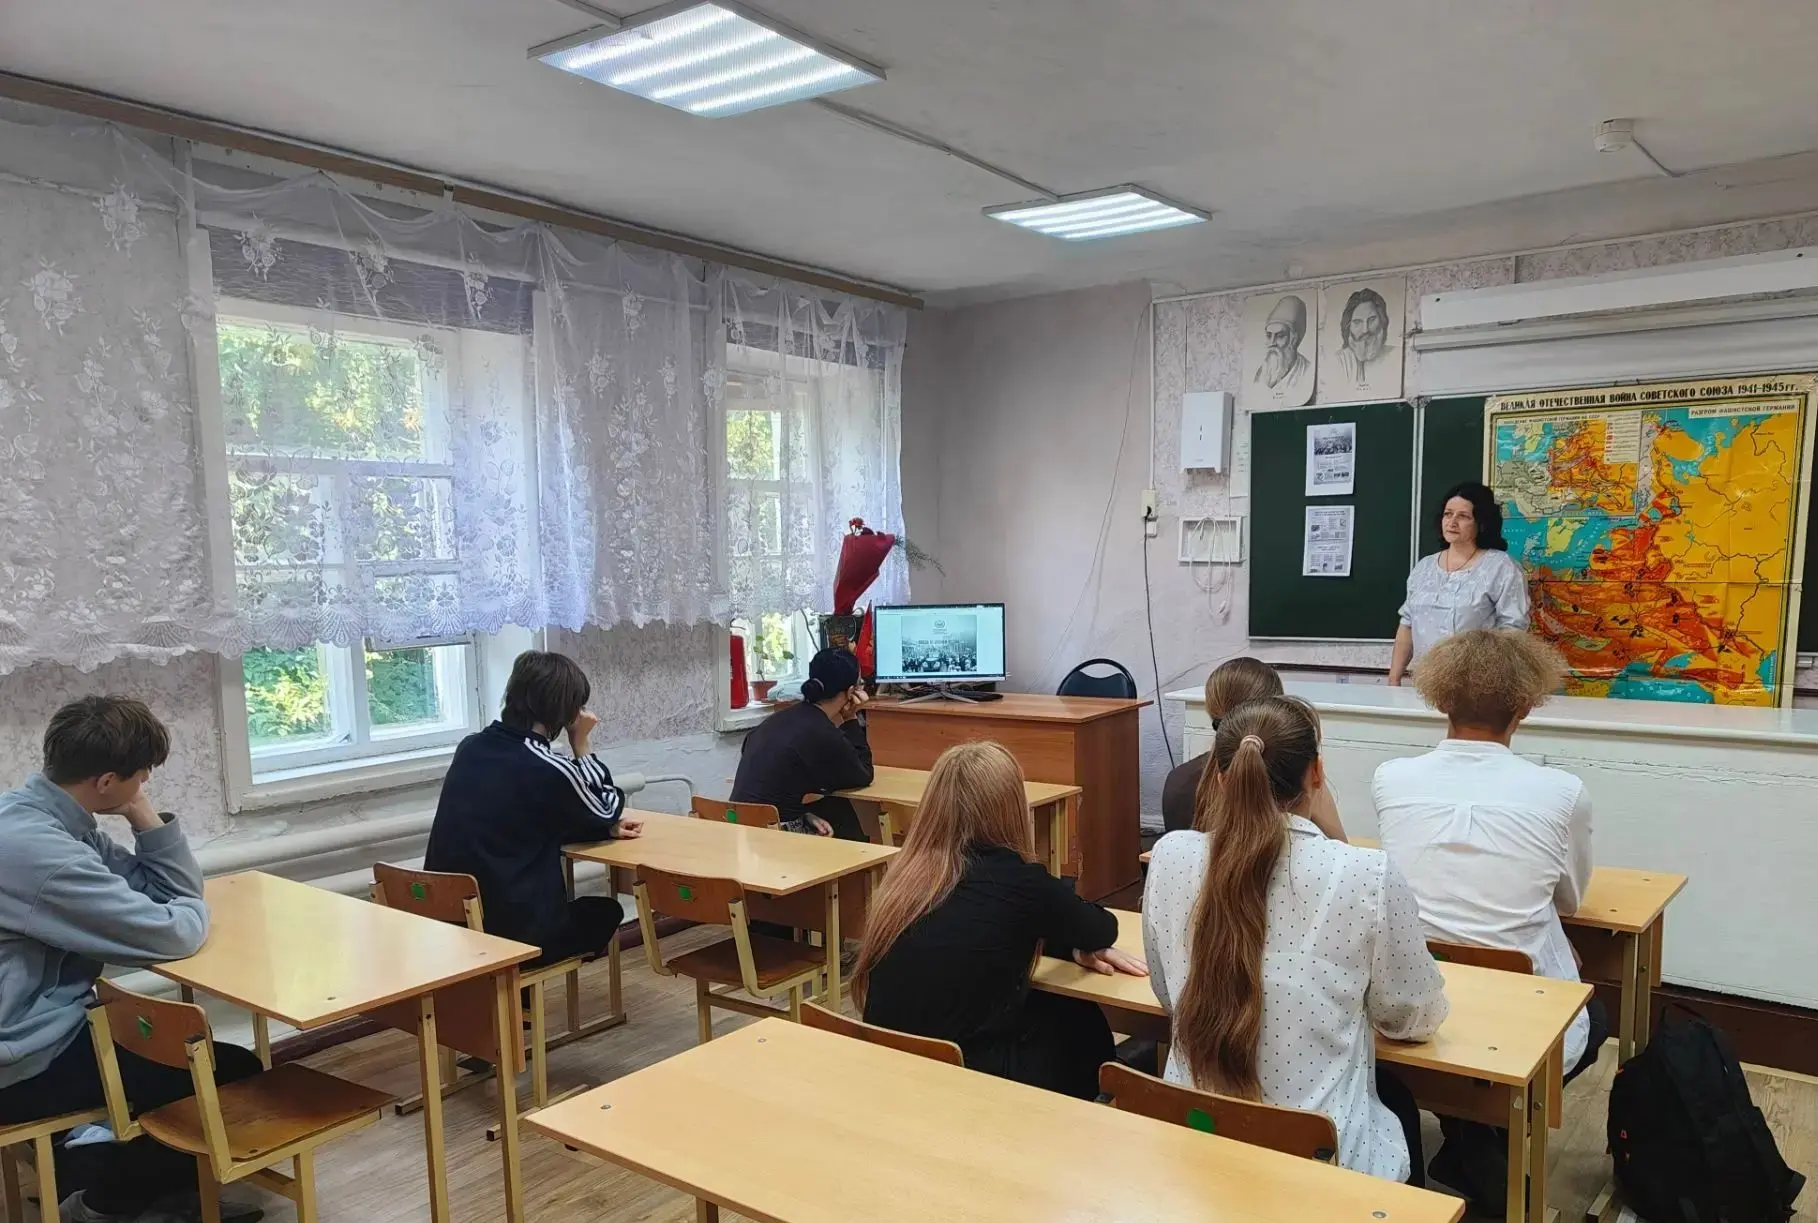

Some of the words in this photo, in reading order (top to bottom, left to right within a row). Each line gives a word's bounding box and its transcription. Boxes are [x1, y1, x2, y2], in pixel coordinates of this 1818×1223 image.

[1501, 400, 1535, 411] ВЕЛИКАЯ
[1539, 394, 1606, 407] ОТЕЧЕСТВЕННАЯ
[1609, 391, 1637, 402] ВОЙНА
[1640, 388, 1696, 400] СОВЕТСКОГО
[1700, 385, 1733, 397] СОЮЗА
[1691, 408, 1717, 416] РАЗГРОМ
